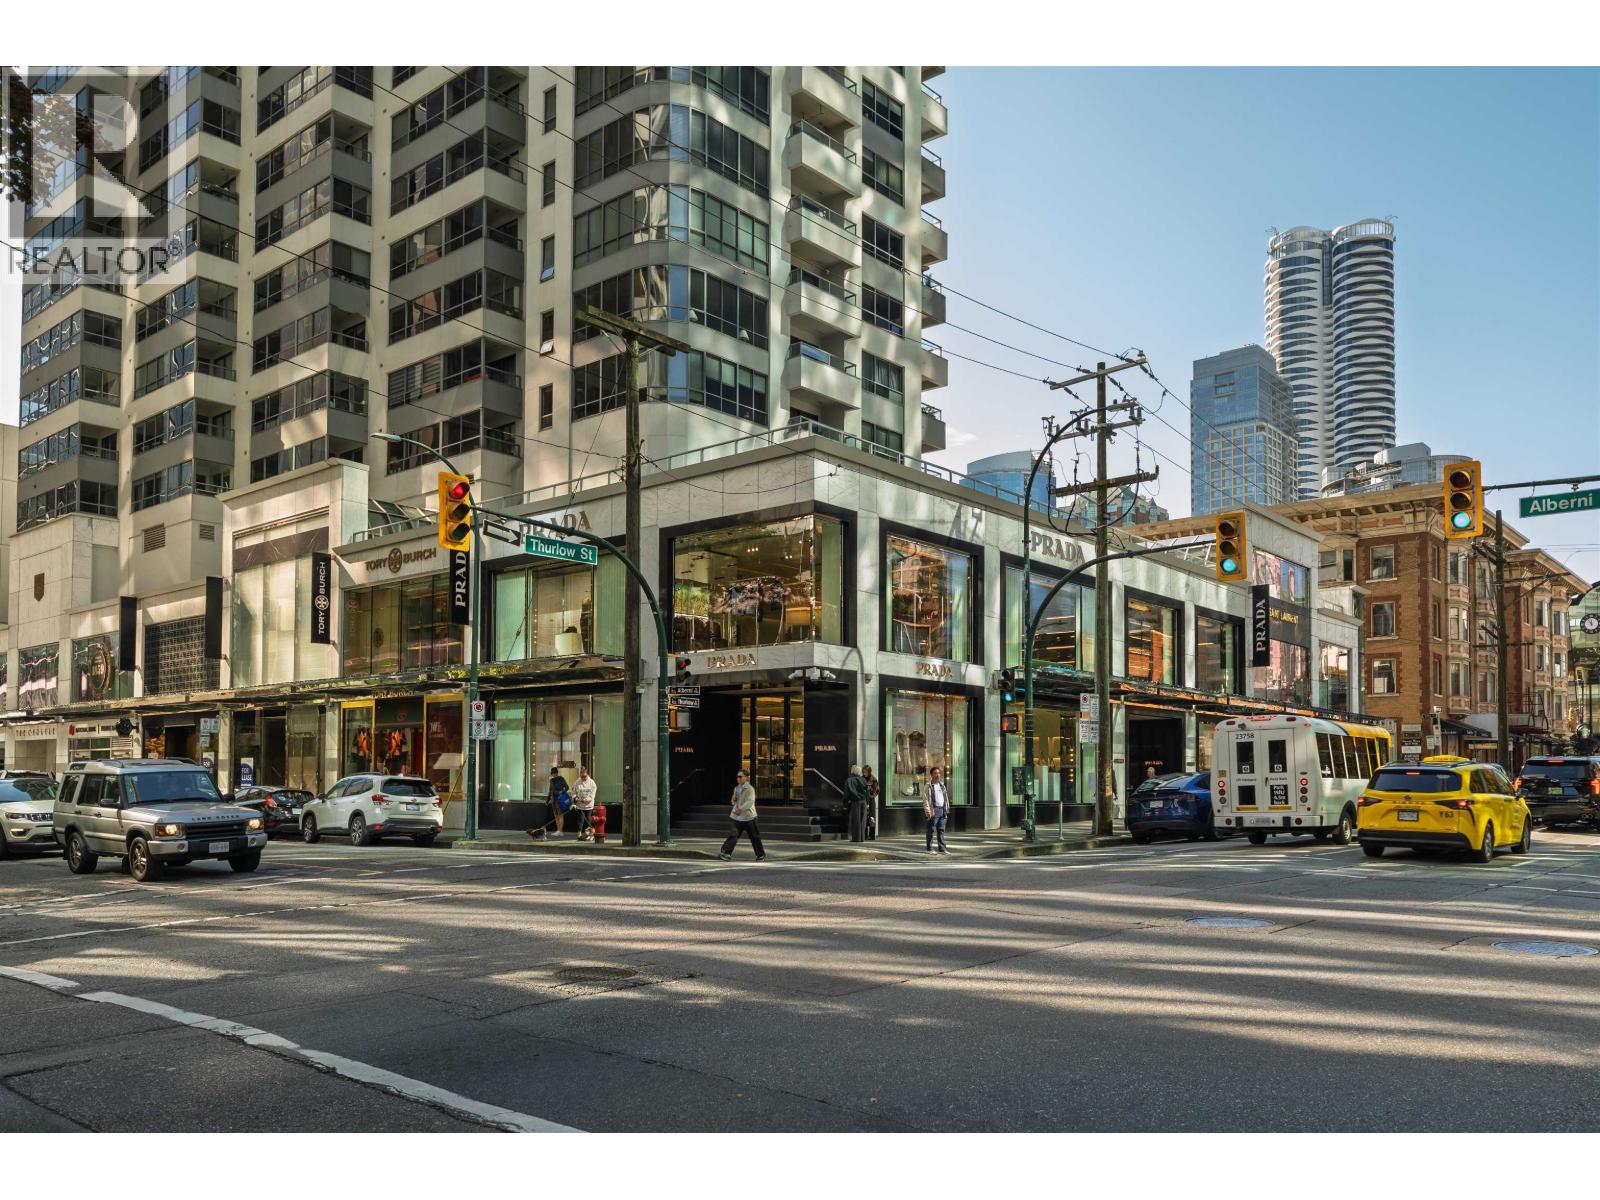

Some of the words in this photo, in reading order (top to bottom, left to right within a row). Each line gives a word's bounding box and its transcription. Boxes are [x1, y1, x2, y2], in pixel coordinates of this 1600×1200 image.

[1529, 493, 1593, 513] Alberni
[530, 538, 575, 557] Thurlow
[580, 547, 593, 560] St
[1031, 530, 1086, 565] PRADA
[365, 558, 388, 571] TORY
[403, 548, 437, 563] BURCH
[455, 551, 467, 607] PRAD
[1256, 599, 1266, 652] PRADA
[706, 653, 756, 670] PRADA
[916, 661, 953, 678] PRADA
